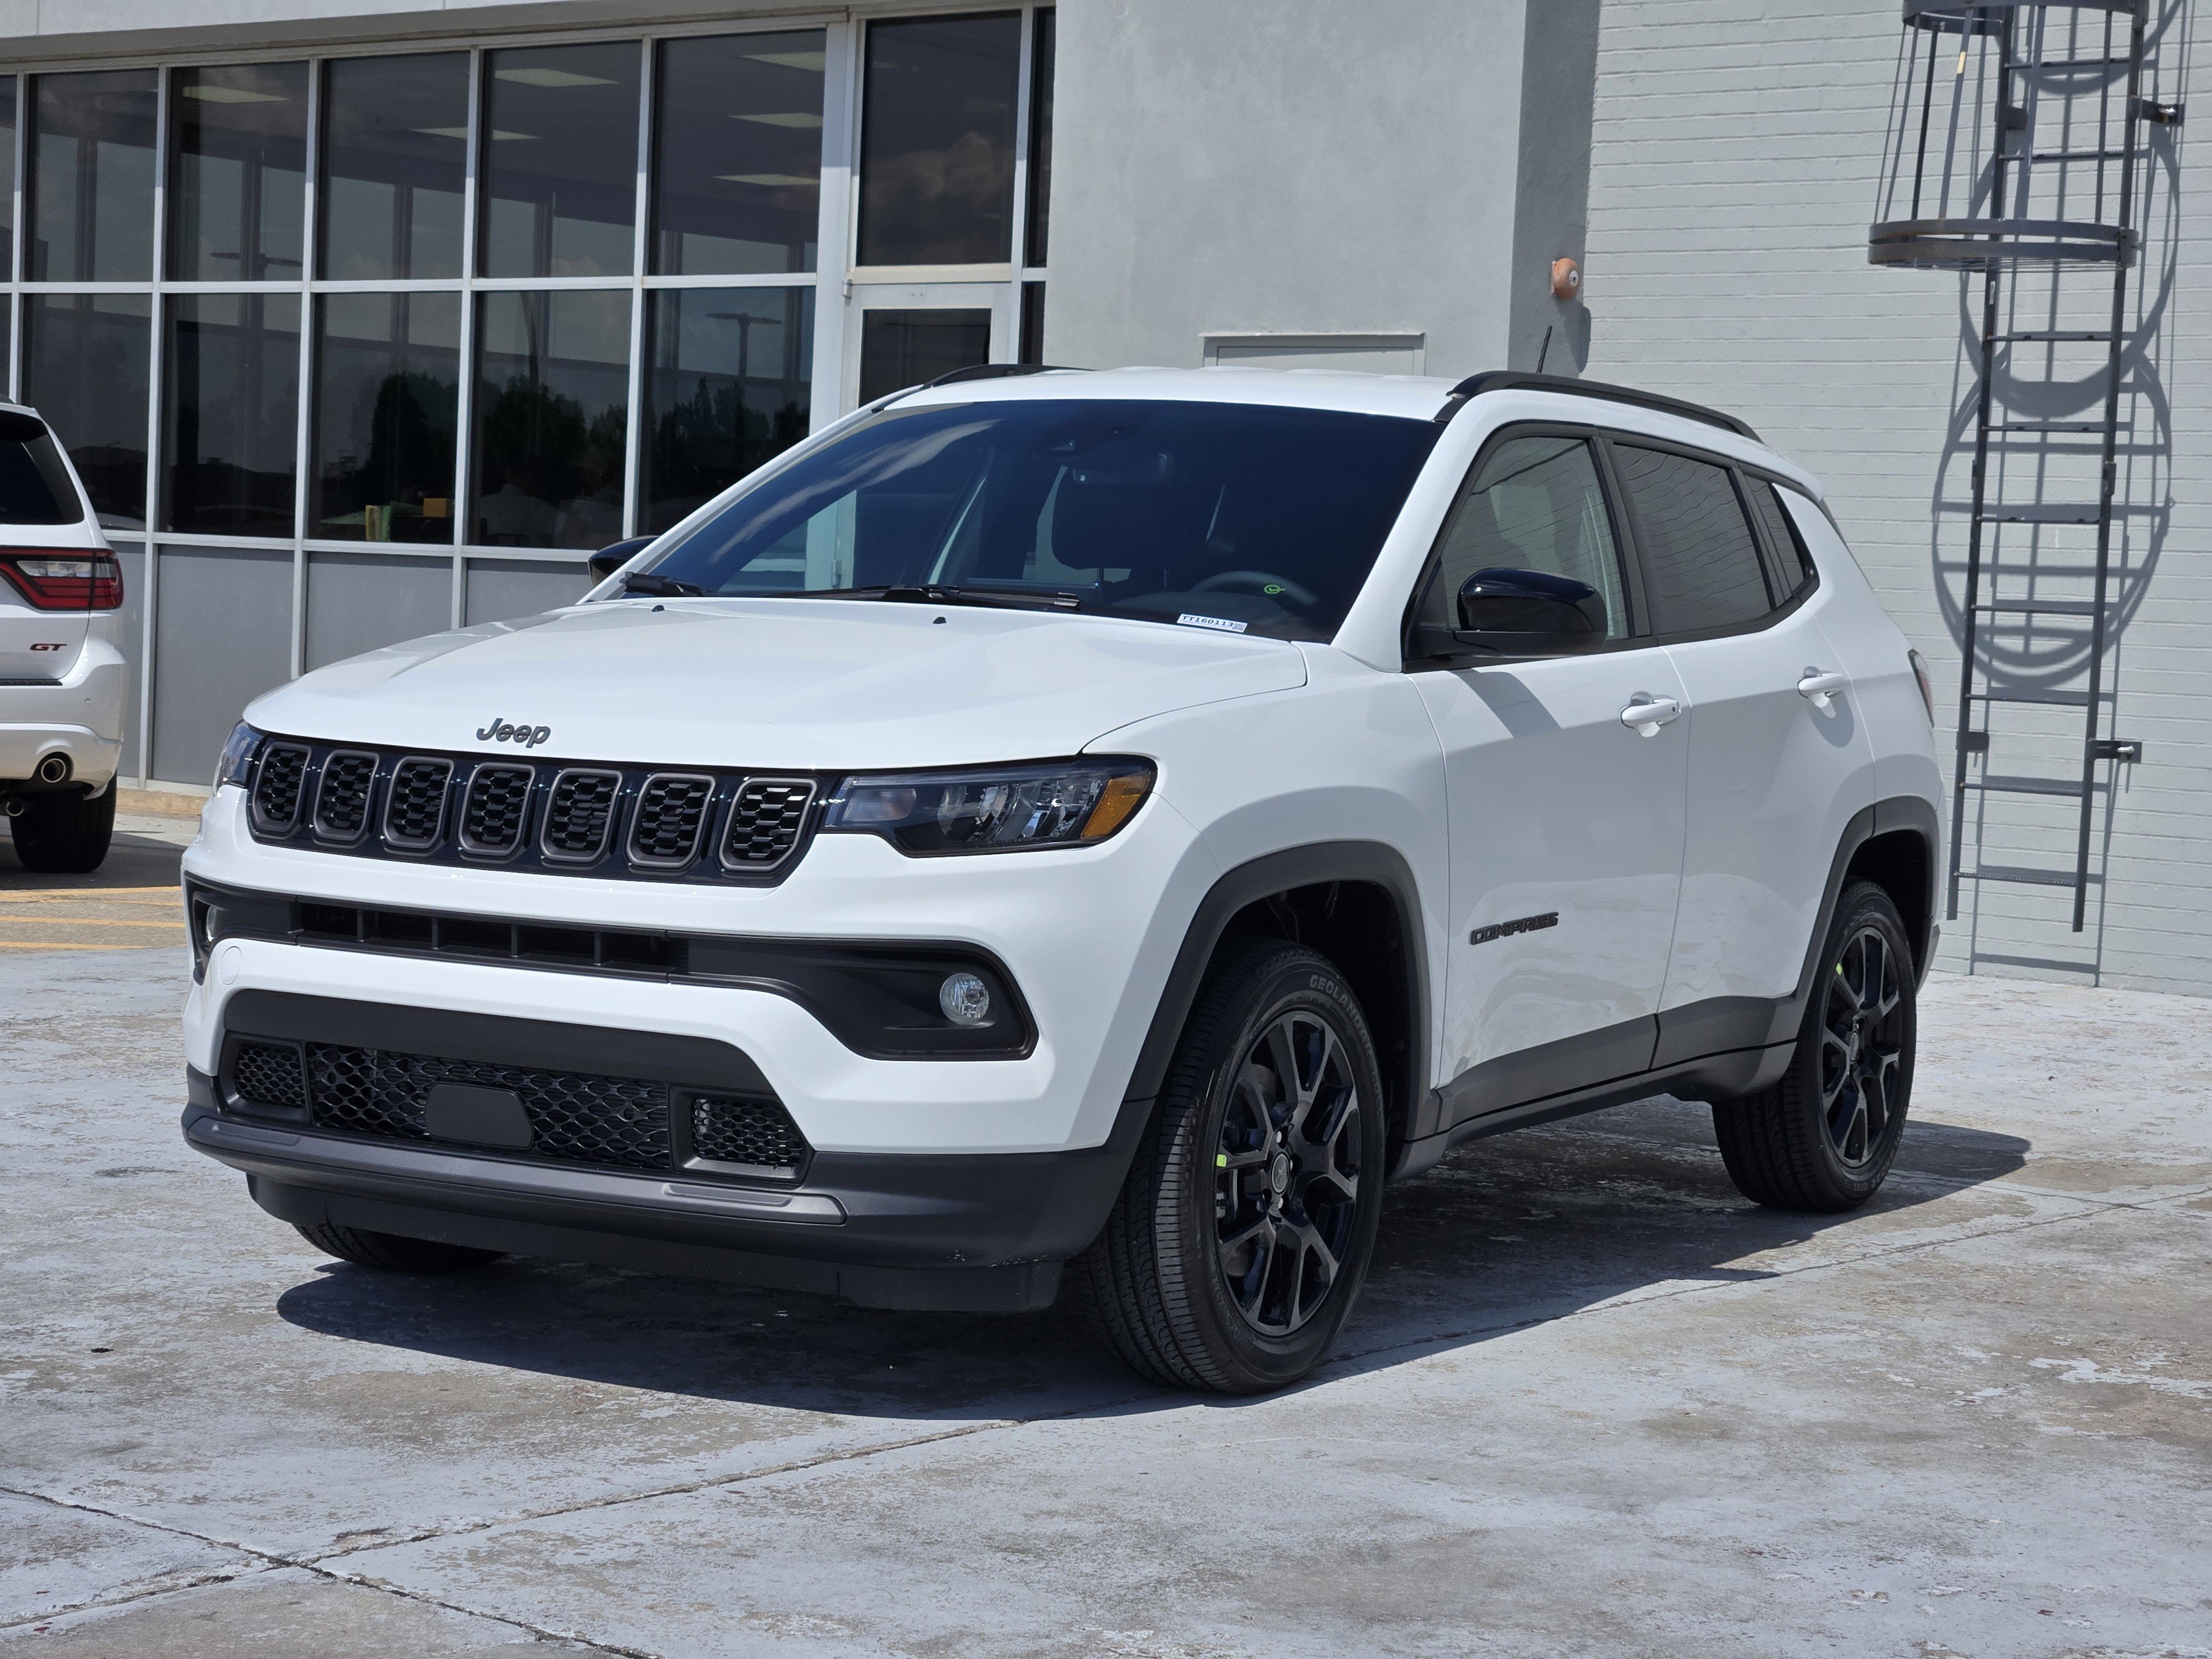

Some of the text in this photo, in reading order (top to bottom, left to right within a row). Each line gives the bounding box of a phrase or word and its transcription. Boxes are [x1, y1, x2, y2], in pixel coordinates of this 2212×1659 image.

[1182, 615, 1234, 627] TT160113
[476, 718, 551, 748] Jeep
[1469, 912, 1559, 945] COMPASS
[1309, 974, 1373, 1056] GEOLANDAR
